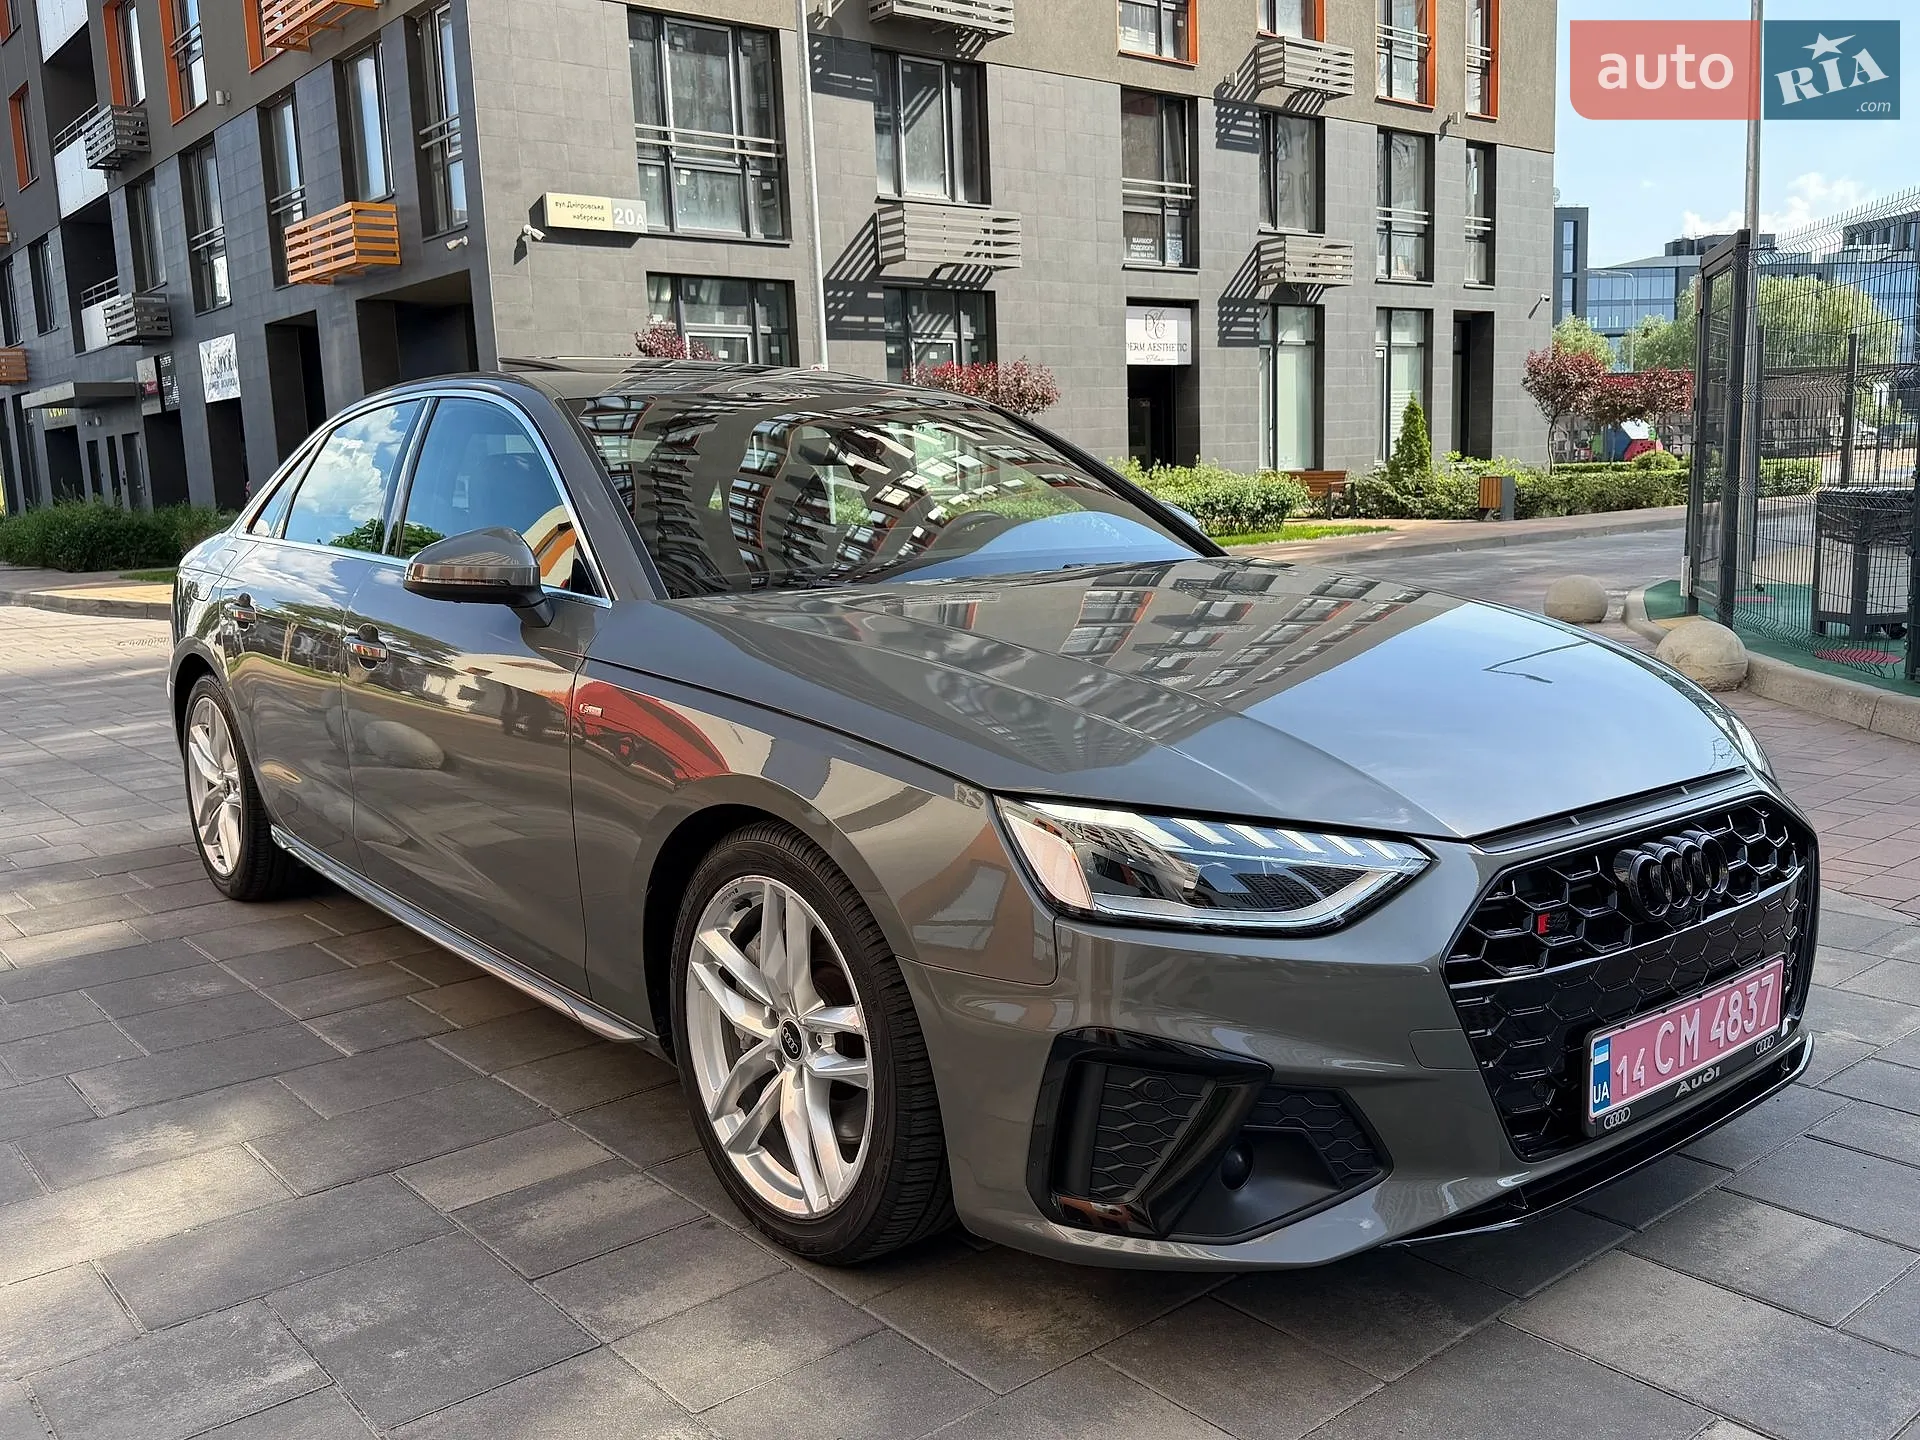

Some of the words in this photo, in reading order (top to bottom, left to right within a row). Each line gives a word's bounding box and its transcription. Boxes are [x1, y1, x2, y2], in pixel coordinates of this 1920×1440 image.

[1615, 1047, 1646, 1096] 14
[1654, 1007, 1701, 1075] CM
[1710, 972, 1775, 1050] 4837
[1593, 1083, 1610, 1104] UA
[1675, 1065, 1721, 1099] Audi
